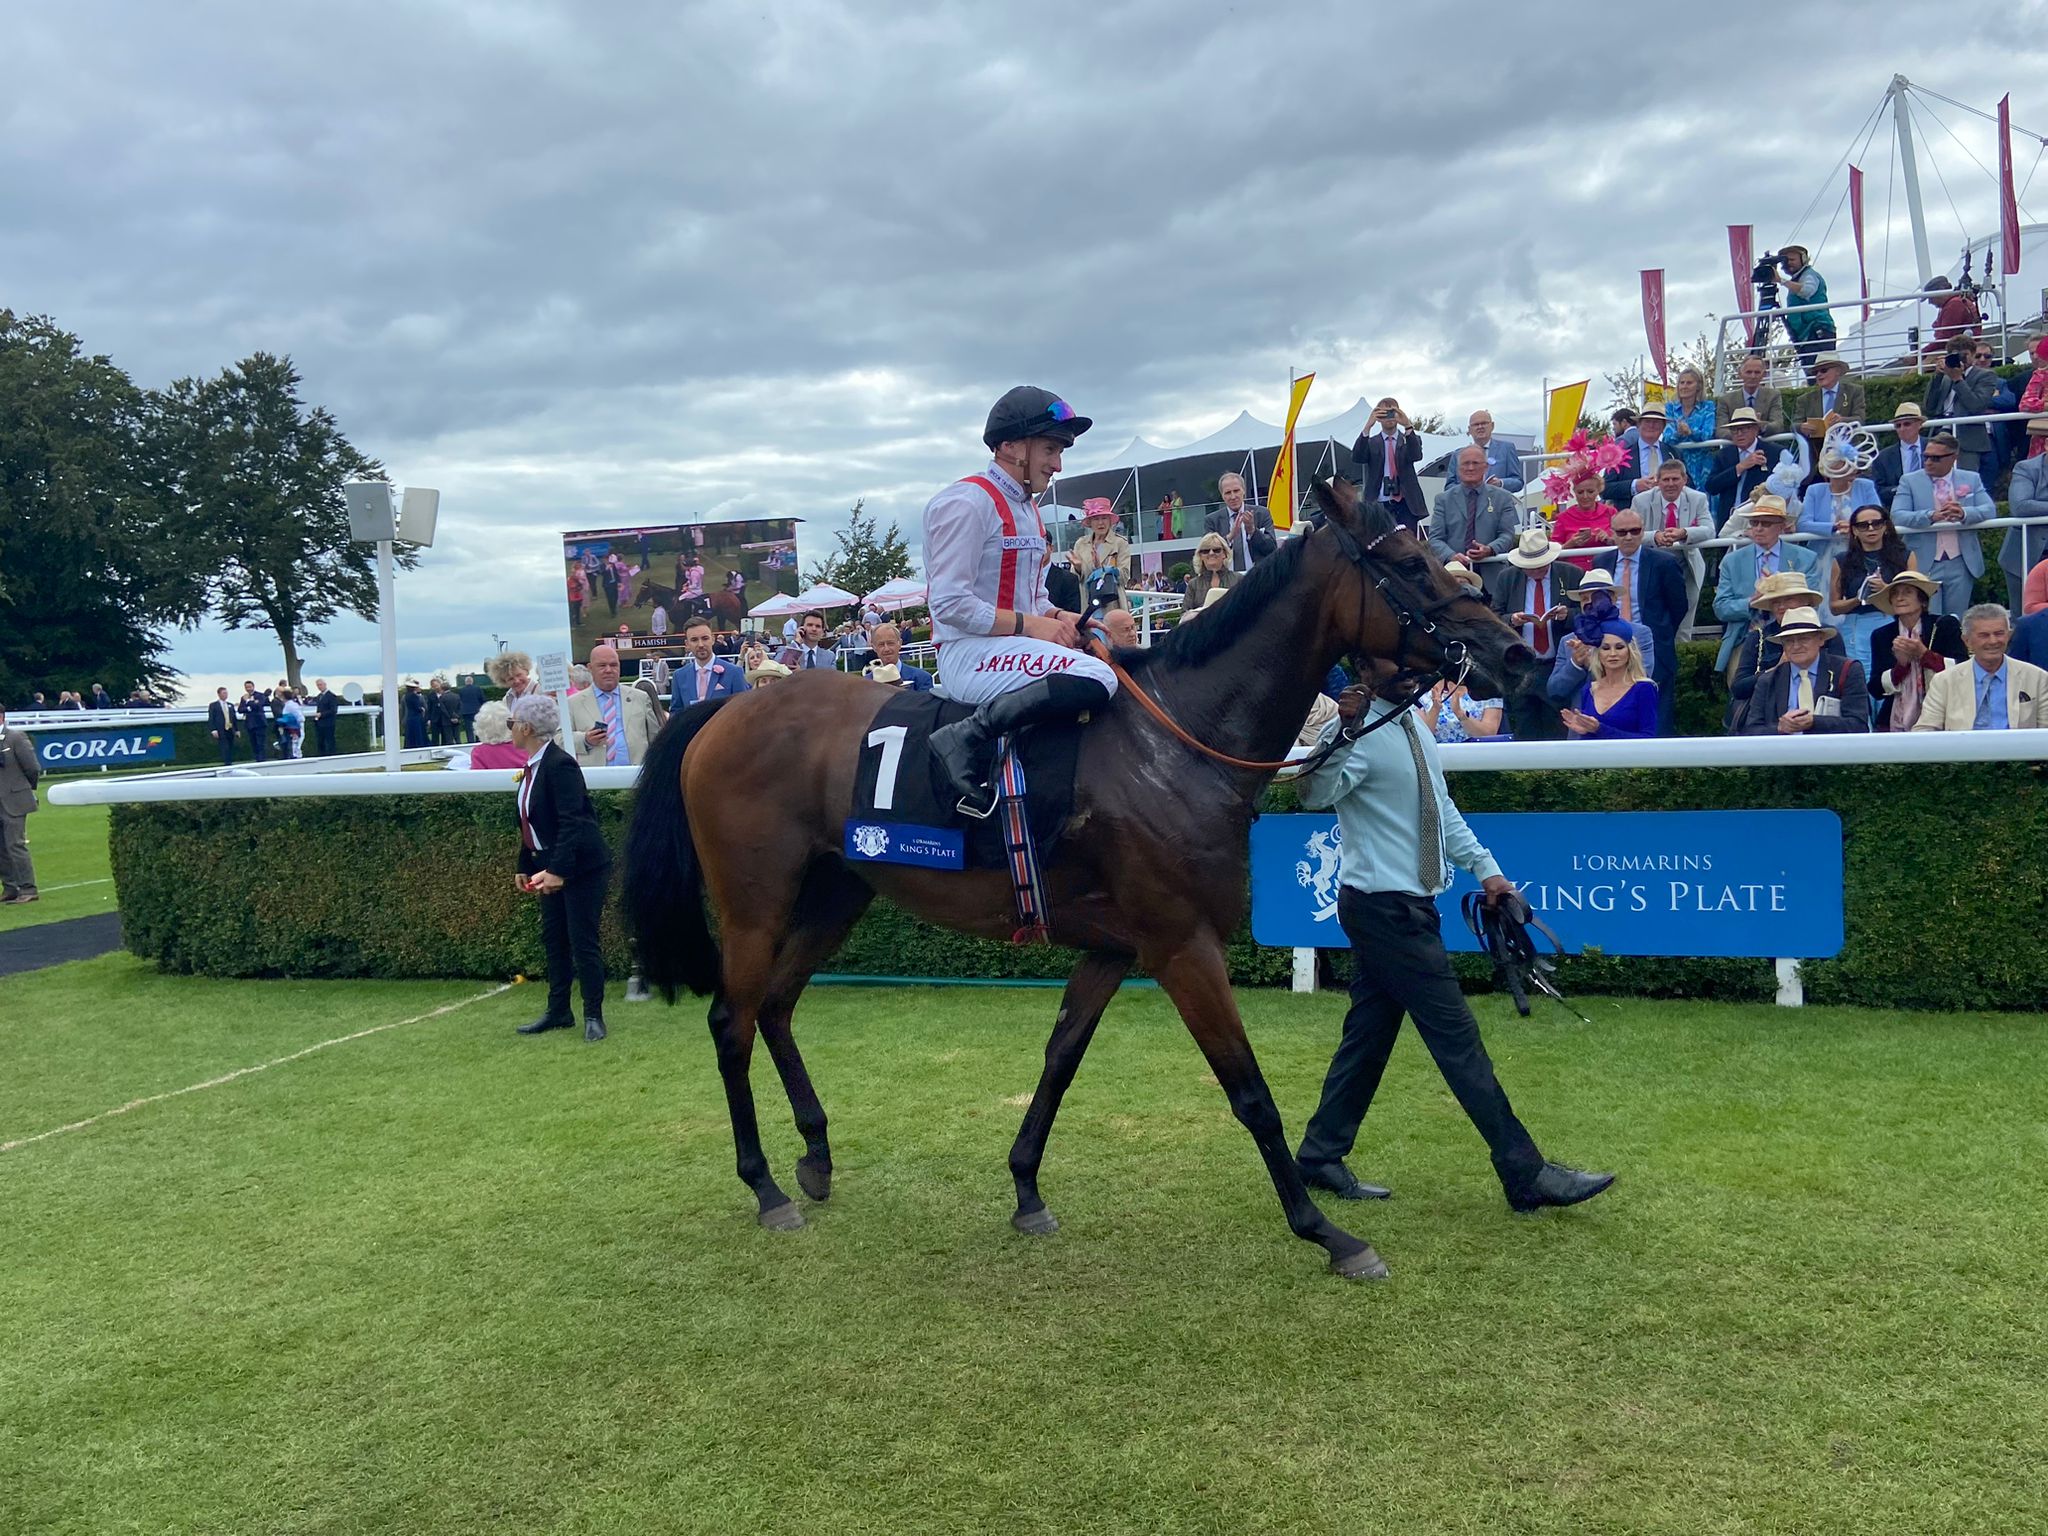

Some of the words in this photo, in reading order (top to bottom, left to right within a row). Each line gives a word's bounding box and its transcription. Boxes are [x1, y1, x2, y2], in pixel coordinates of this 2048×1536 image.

[1003, 537, 1031, 548] BROOK
[634, 638, 667, 647] HAMISH
[42, 737, 147, 760] CORAL
[868, 725, 908, 809] 1
[900, 843, 929, 855] KING'S
[931, 847, 956, 857] PLATE
[1573, 854, 1712, 871] L'ORMARINS
[1511, 880, 1647, 912] KING'S
[1668, 881, 1787, 912] PLATE
